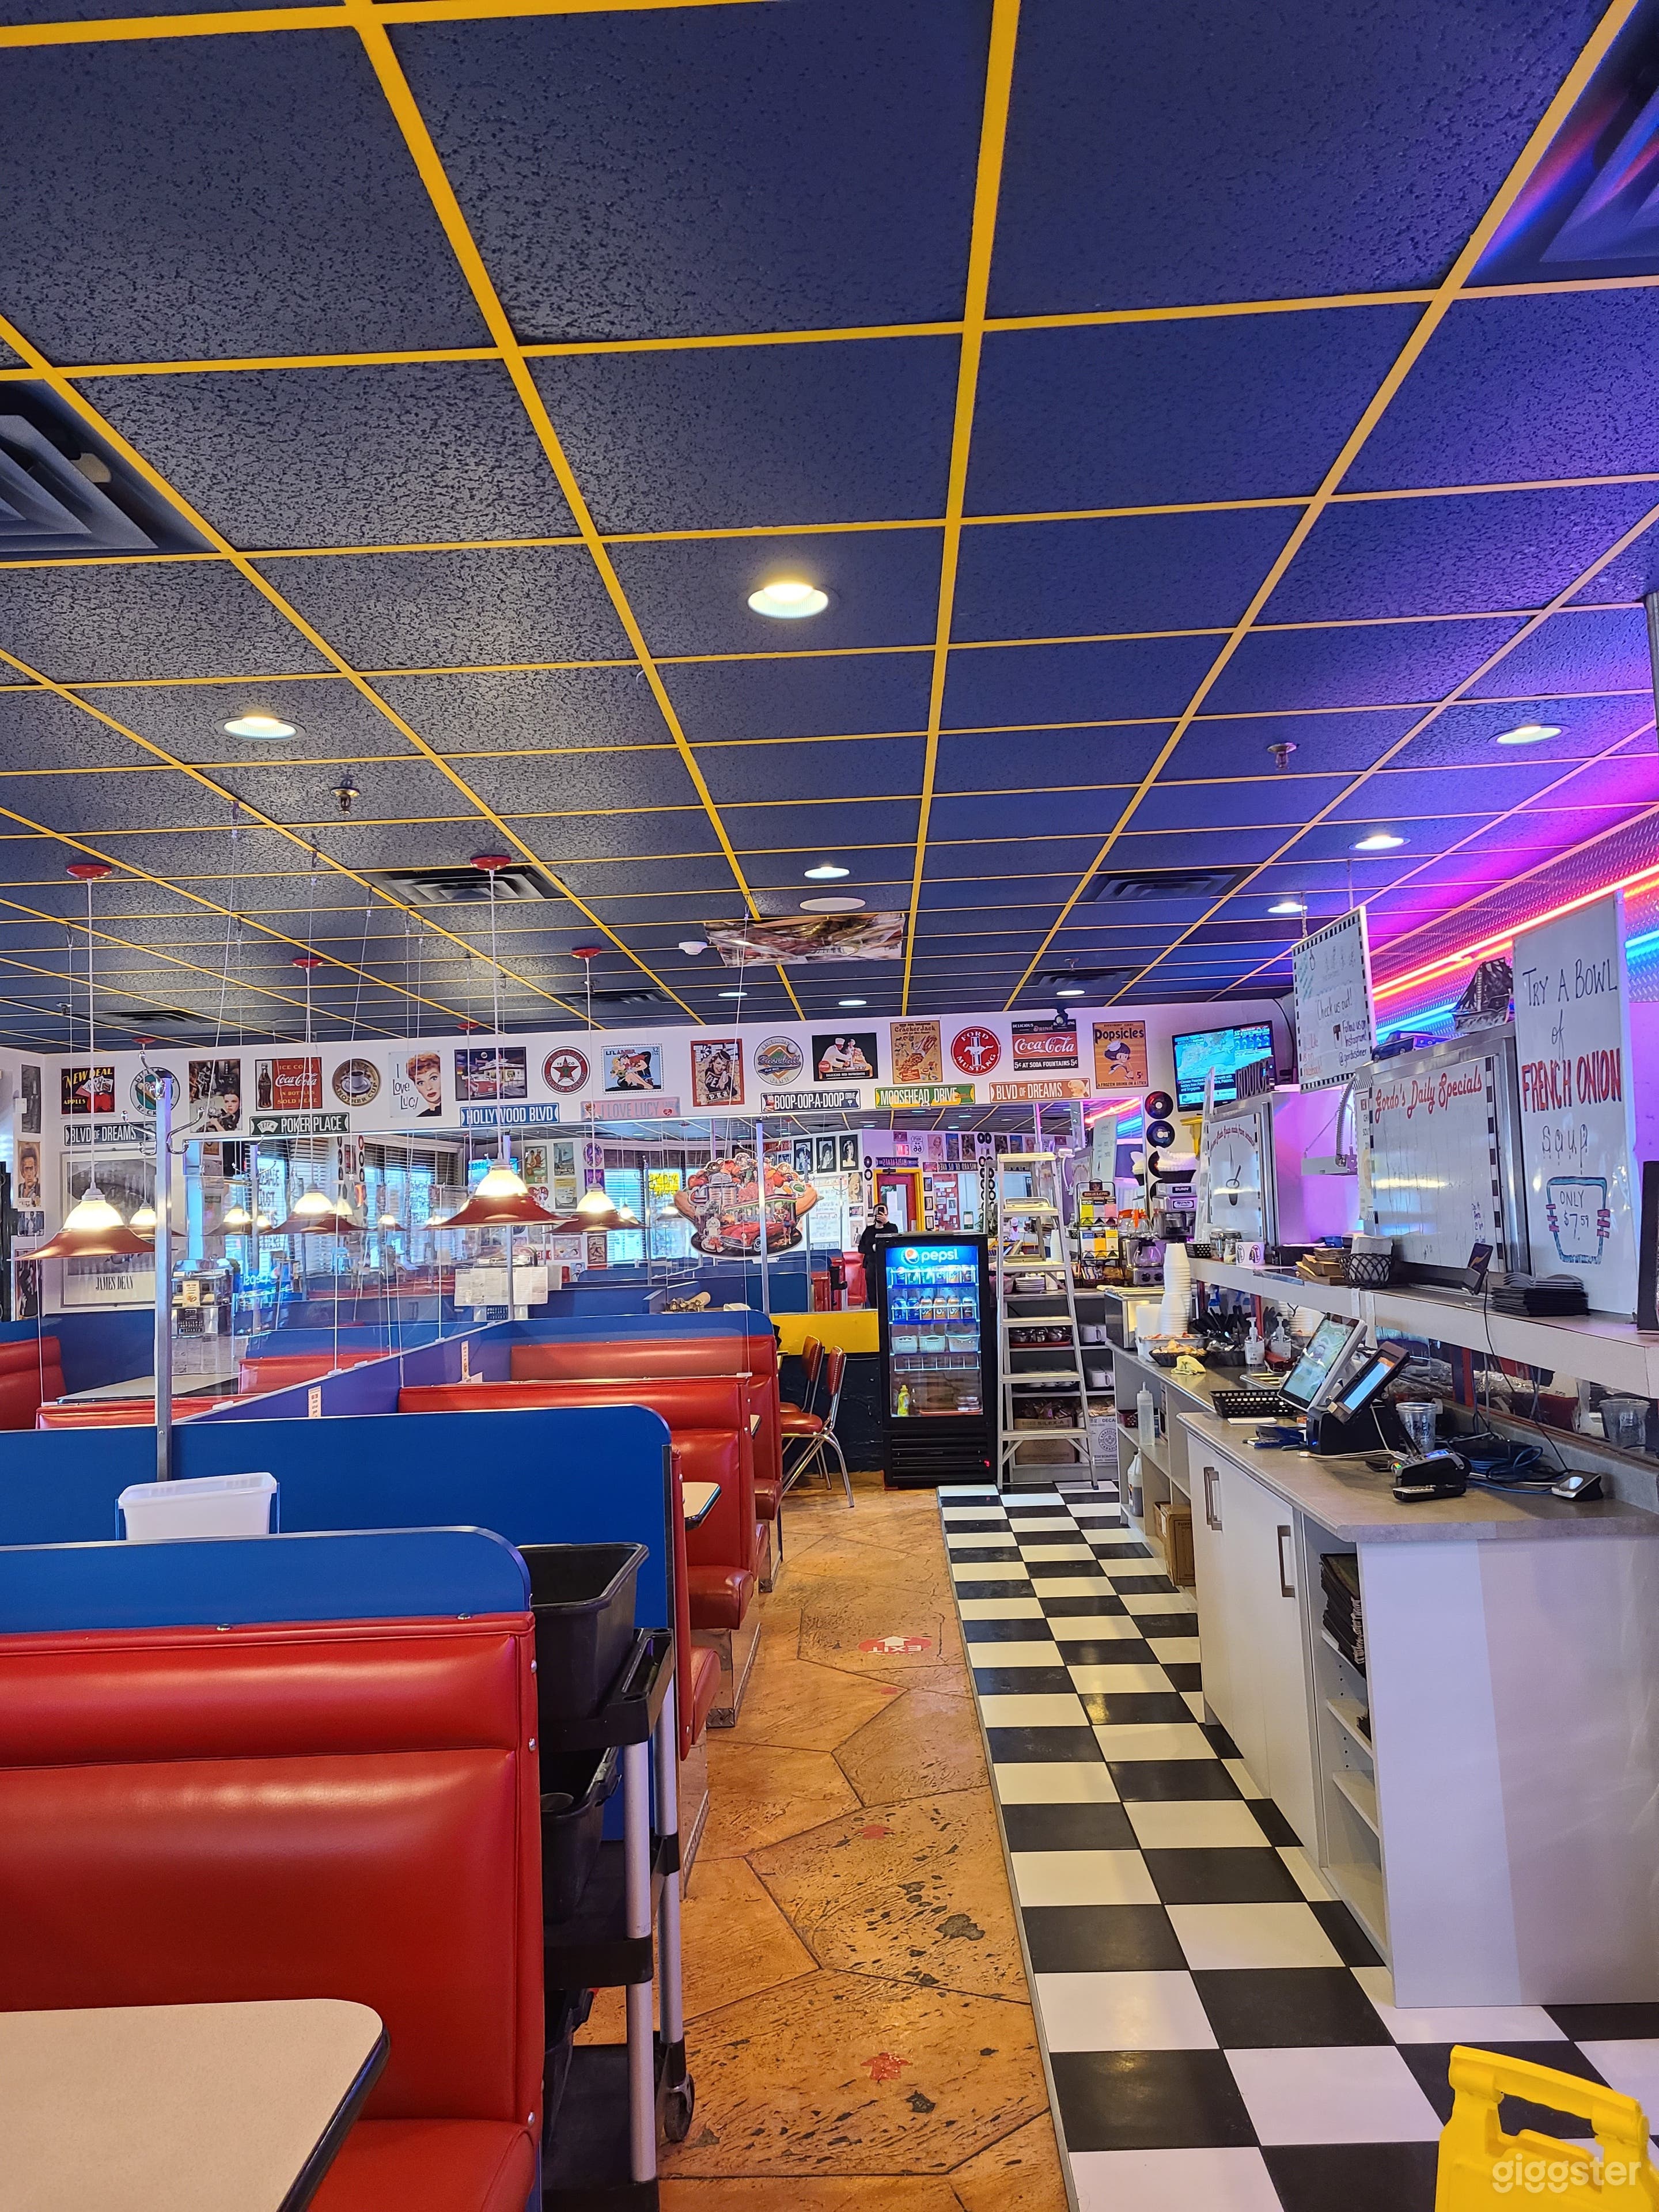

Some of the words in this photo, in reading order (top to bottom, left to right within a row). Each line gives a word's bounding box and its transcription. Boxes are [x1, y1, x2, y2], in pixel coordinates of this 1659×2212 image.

[1522, 967, 1548, 1006] TRY
[1558, 968, 1570, 1002] A
[1575, 958, 1618, 999] BOWL
[961, 1032, 989, 1041] FORD
[1094, 1028, 1144, 1044] Popsicles
[1551, 1009, 1565, 1061] of
[1014, 1036, 1075, 1055] Coca-Cola
[396, 1063, 399, 1078] I
[956, 1054, 996, 1071] MUSTANG
[62, 1070, 89, 1089] NEW
[275, 1072, 318, 1088] Coca-Cola
[1521, 1059, 1572, 1113] FRENCH
[1577, 1048, 1622, 1105] ONION
[335, 1084, 368, 1104] ANOTHER
[368, 1082, 378, 1098] CUP
[881, 1088, 930, 1105] MOOSEHEAD
[934, 1087, 957, 1103] DRIVE
[996, 1084, 1017, 1100] BLVD
[1019, 1088, 1026, 1096] OF
[1028, 1082, 1063, 1098] DREAMS
[1375, 1084, 1406, 1124] Gordo's
[1407, 1076, 1435, 1119] Daily
[1438, 1065, 1482, 1111] Specials
[775, 1092, 844, 1109] BOOP-OOP-A-DOOP
[467, 1107, 526, 1124] HOLLYWOOD
[530, 1105, 554, 1122] BLVD
[609, 1103, 631, 1118] LOVE
[635, 1101, 660, 1117] LUCY
[281, 1116, 311, 1133] POKER
[313, 1115, 342, 1132] PLACE
[71, 1127, 91, 1143] BLVD
[102, 1126, 137, 1142] DREAMS
[1559, 1190, 1585, 1209] ONLY
[921, 1248, 959, 1263] pepsi
[95, 1276, 116, 1290] JAMES
[117, 1275, 134, 1290] DEAN
[1100, 1429, 1116, 1439] BRAZILIA
[1101, 1443, 1118, 1452] CANADIA
